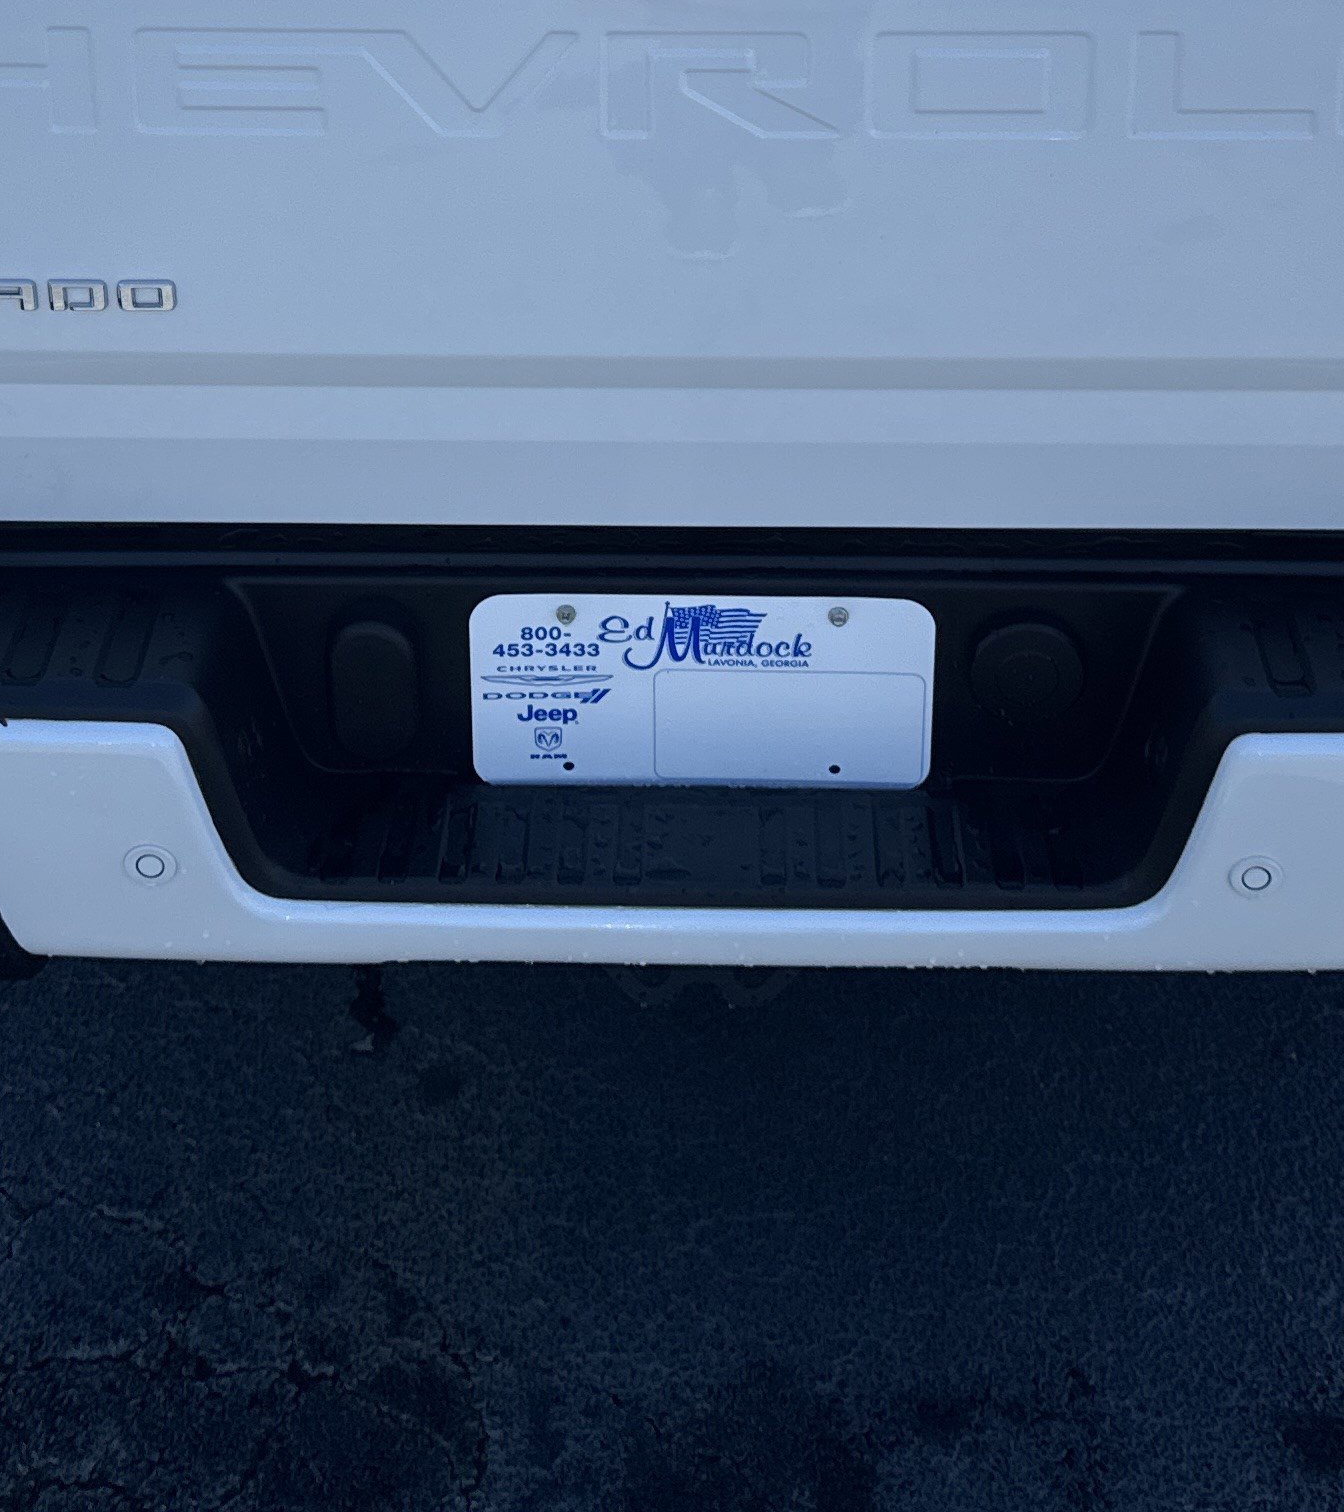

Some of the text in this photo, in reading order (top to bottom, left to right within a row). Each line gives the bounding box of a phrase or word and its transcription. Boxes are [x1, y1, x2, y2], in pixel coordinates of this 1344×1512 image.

[520, 626, 572, 641] 800-
[596, 612, 813, 670] Ed Murdock
[492, 643, 600, 657] 453-3433
[707, 658, 810, 668] LAVONIA, GEORGIA
[517, 704, 578, 725] Jeep
